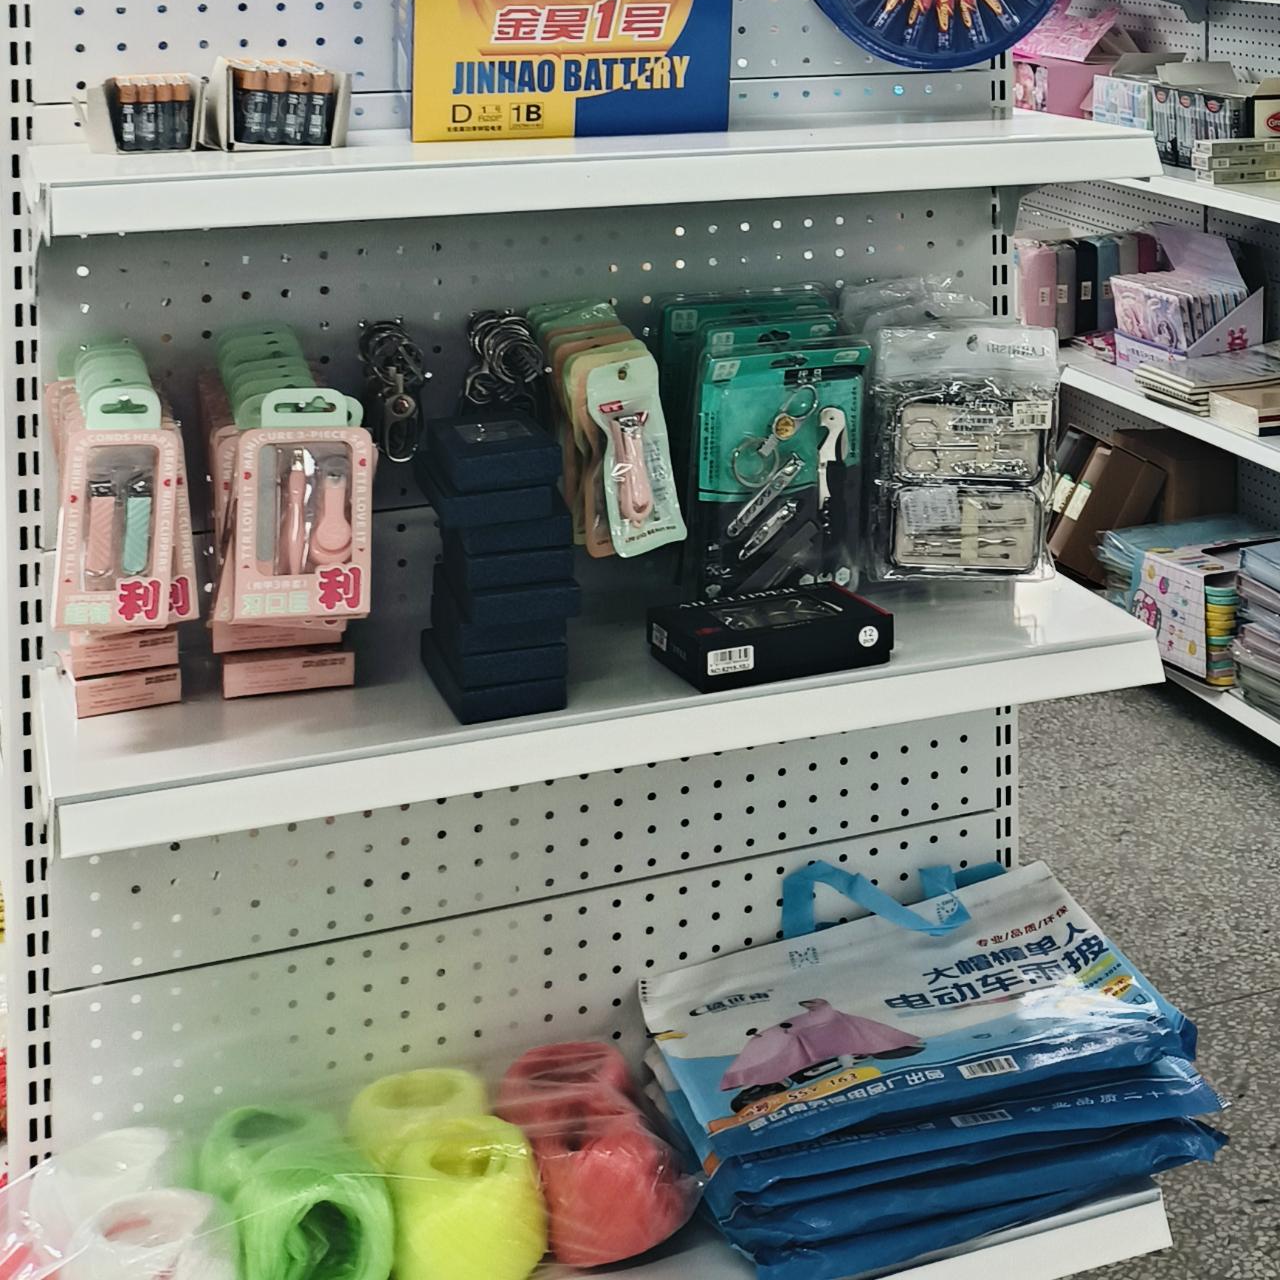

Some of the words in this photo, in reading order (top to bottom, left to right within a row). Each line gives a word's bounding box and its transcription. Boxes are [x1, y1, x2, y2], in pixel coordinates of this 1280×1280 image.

[452, 60, 556, 96] JINHAO
[562, 56, 691, 92] BATTERY
[451, 104, 473, 124] D
[511, 104, 542, 123] 1B
[117, 579, 162, 622] 利
[318, 567, 361, 611] 利
[863, 627, 875, 639] 12
